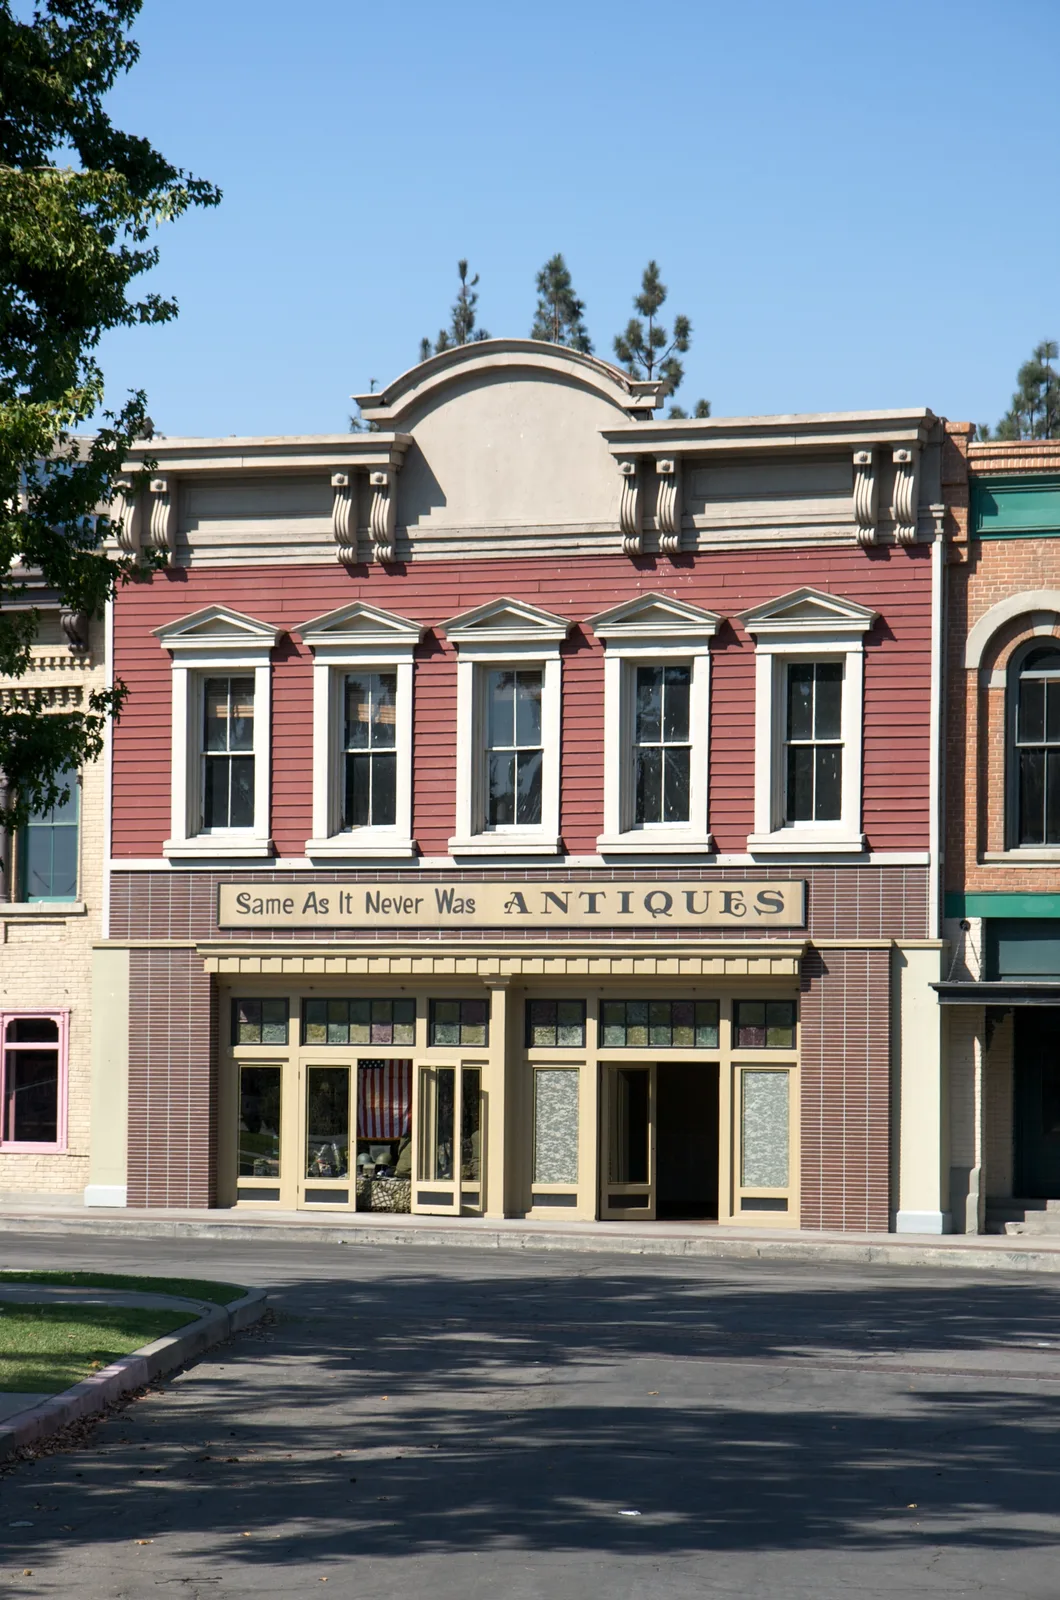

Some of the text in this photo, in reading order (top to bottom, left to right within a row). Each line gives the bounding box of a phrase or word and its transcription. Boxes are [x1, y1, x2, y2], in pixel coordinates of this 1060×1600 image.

[236, 887, 785, 918] Same As It Never Was ANTIQUES
